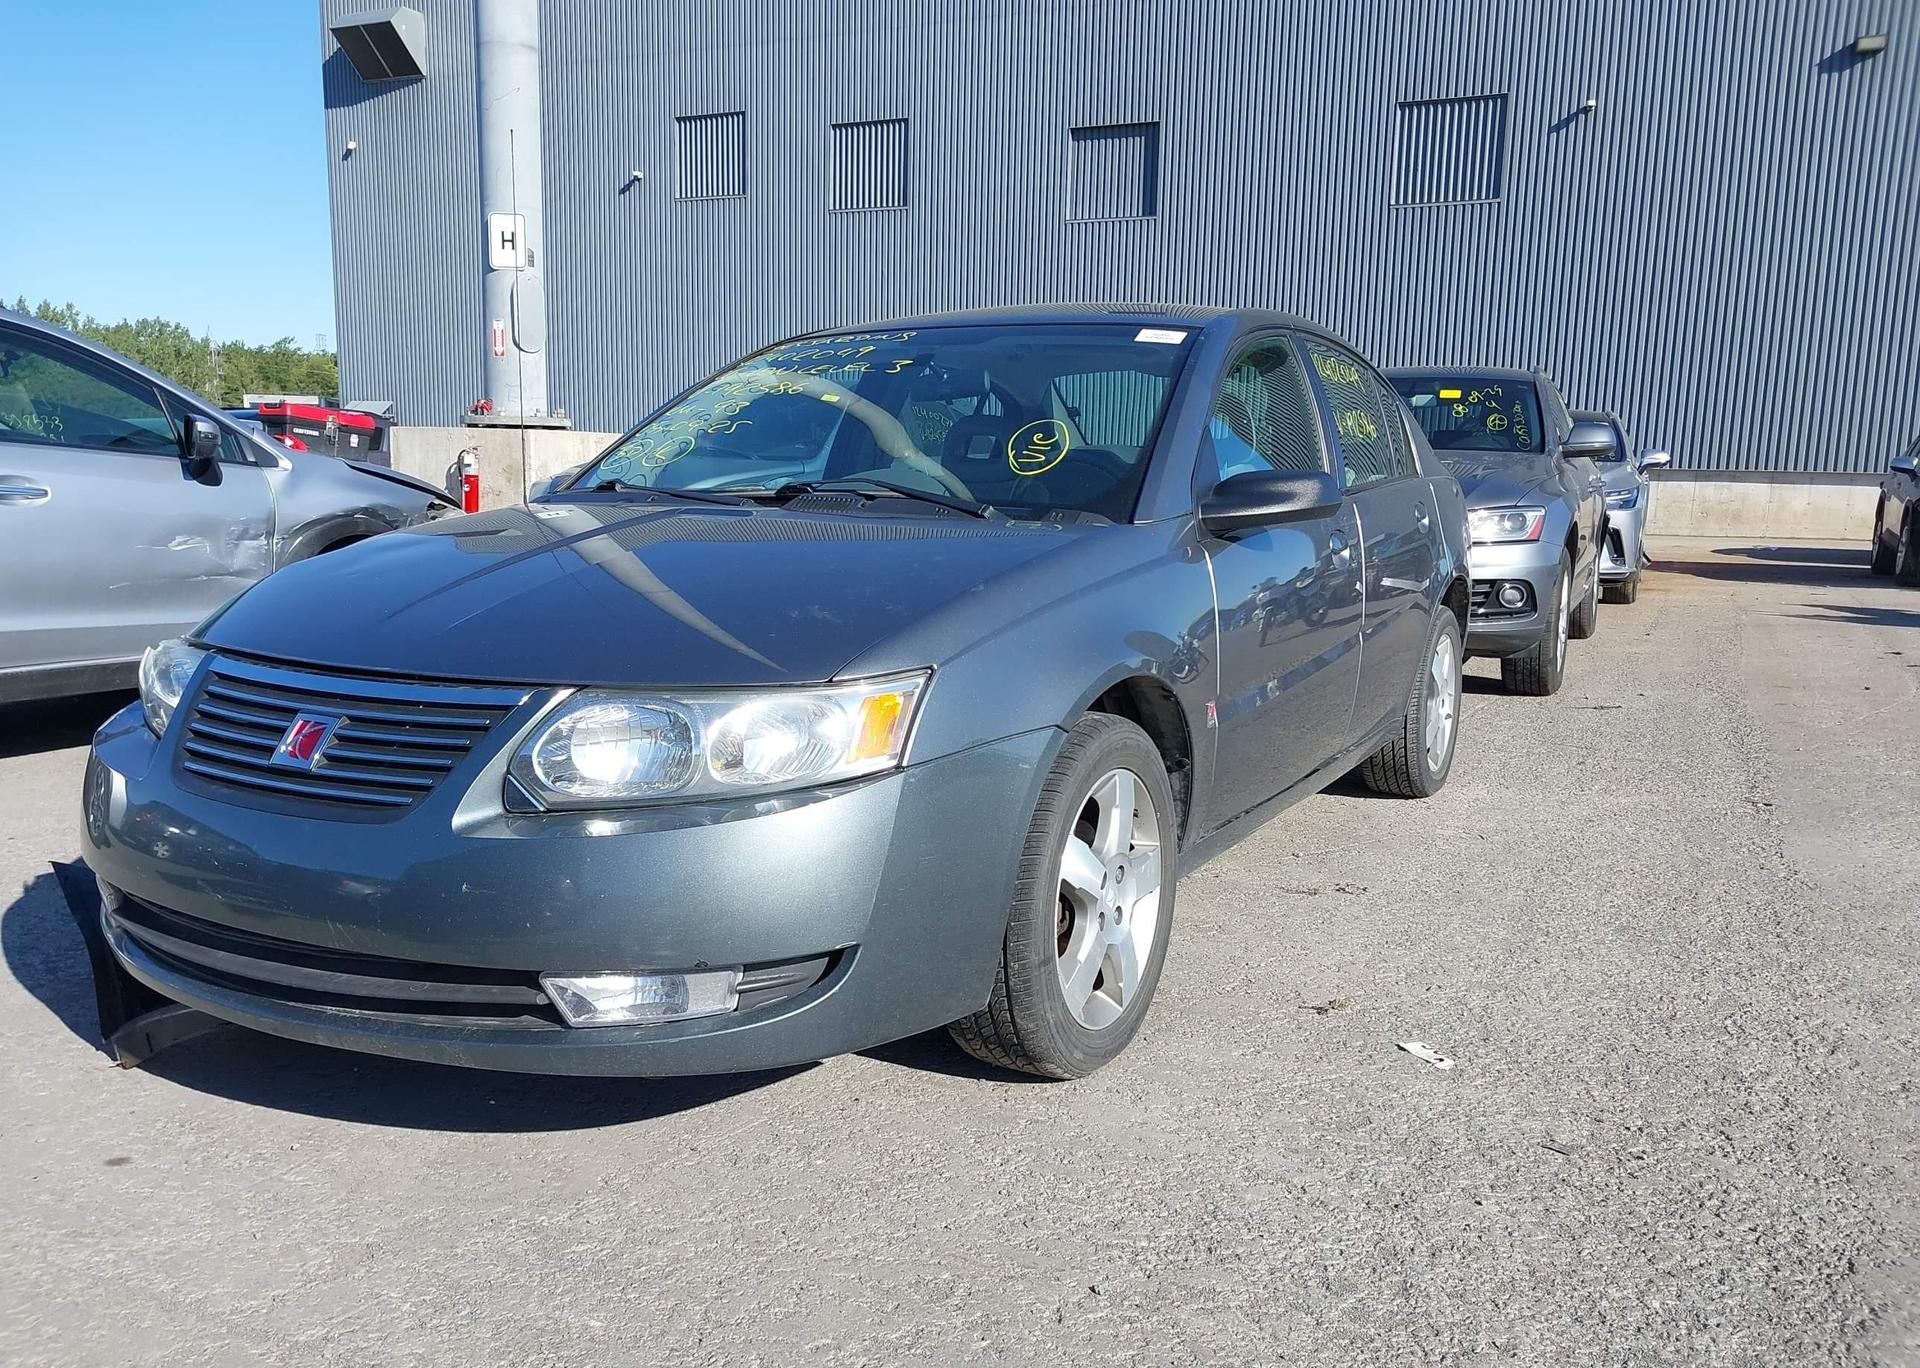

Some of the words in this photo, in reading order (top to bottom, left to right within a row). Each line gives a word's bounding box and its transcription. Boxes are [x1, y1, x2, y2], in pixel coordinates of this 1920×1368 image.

[500, 230, 516, 251] H
[885, 359, 914, 374] 3
[1017, 432, 1059, 462] VIC
